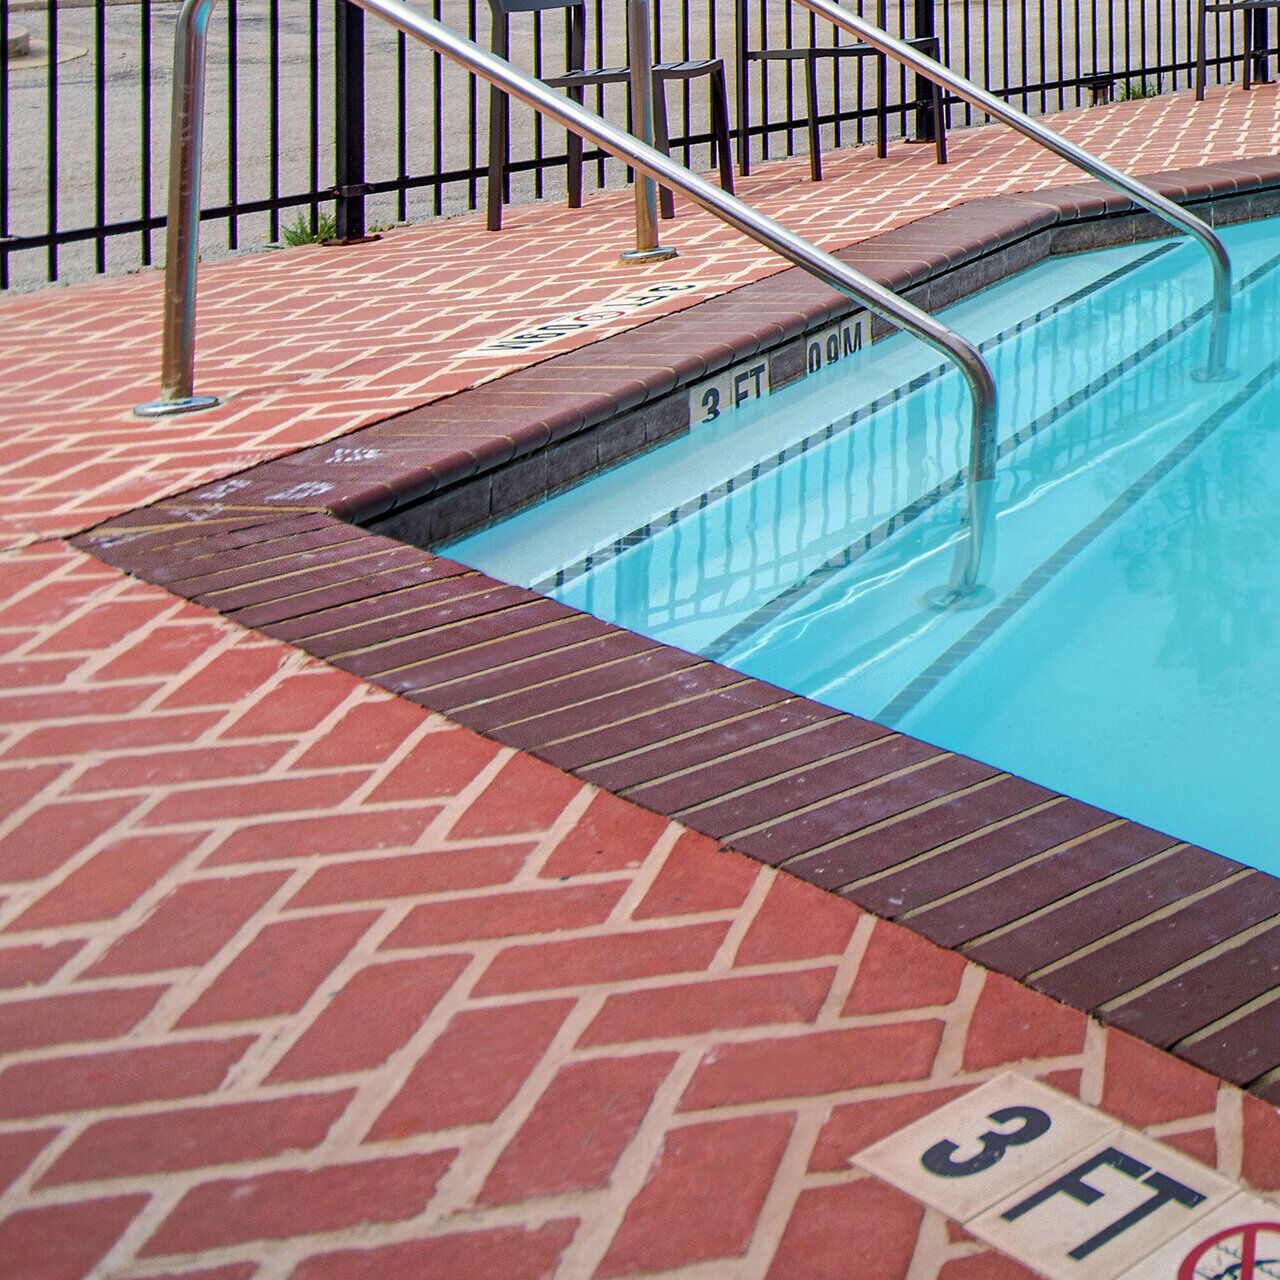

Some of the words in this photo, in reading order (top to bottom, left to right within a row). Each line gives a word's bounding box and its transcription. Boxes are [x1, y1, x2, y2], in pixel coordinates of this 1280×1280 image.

[702, 386, 721, 423] 3
[734, 363, 766, 410] FT
[919, 1105, 1052, 1178] 3
[1000, 1146, 1208, 1262] FT
